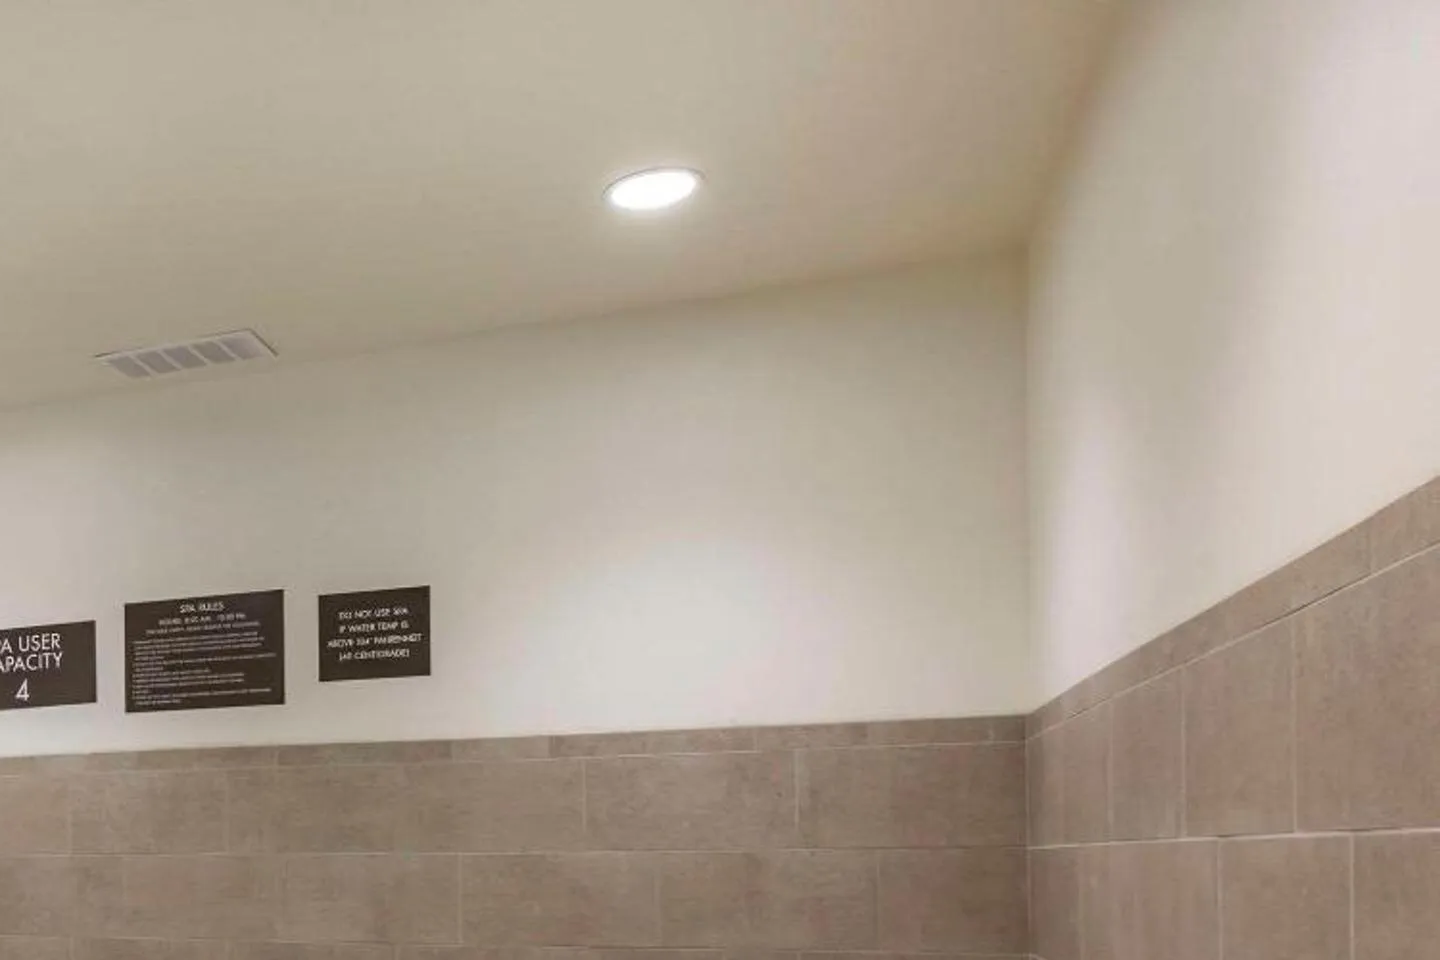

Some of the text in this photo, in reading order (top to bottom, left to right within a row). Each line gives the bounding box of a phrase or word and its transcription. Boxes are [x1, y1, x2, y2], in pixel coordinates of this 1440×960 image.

[180, 603, 197, 614] SPA
[354, 610, 372, 619] NOT
[374, 608, 391, 617] USE
[347, 623, 375, 632] WATER
[377, 621, 399, 631] TEMP
[18, 632, 61, 652] USER
[15, 678, 31, 701] 4
